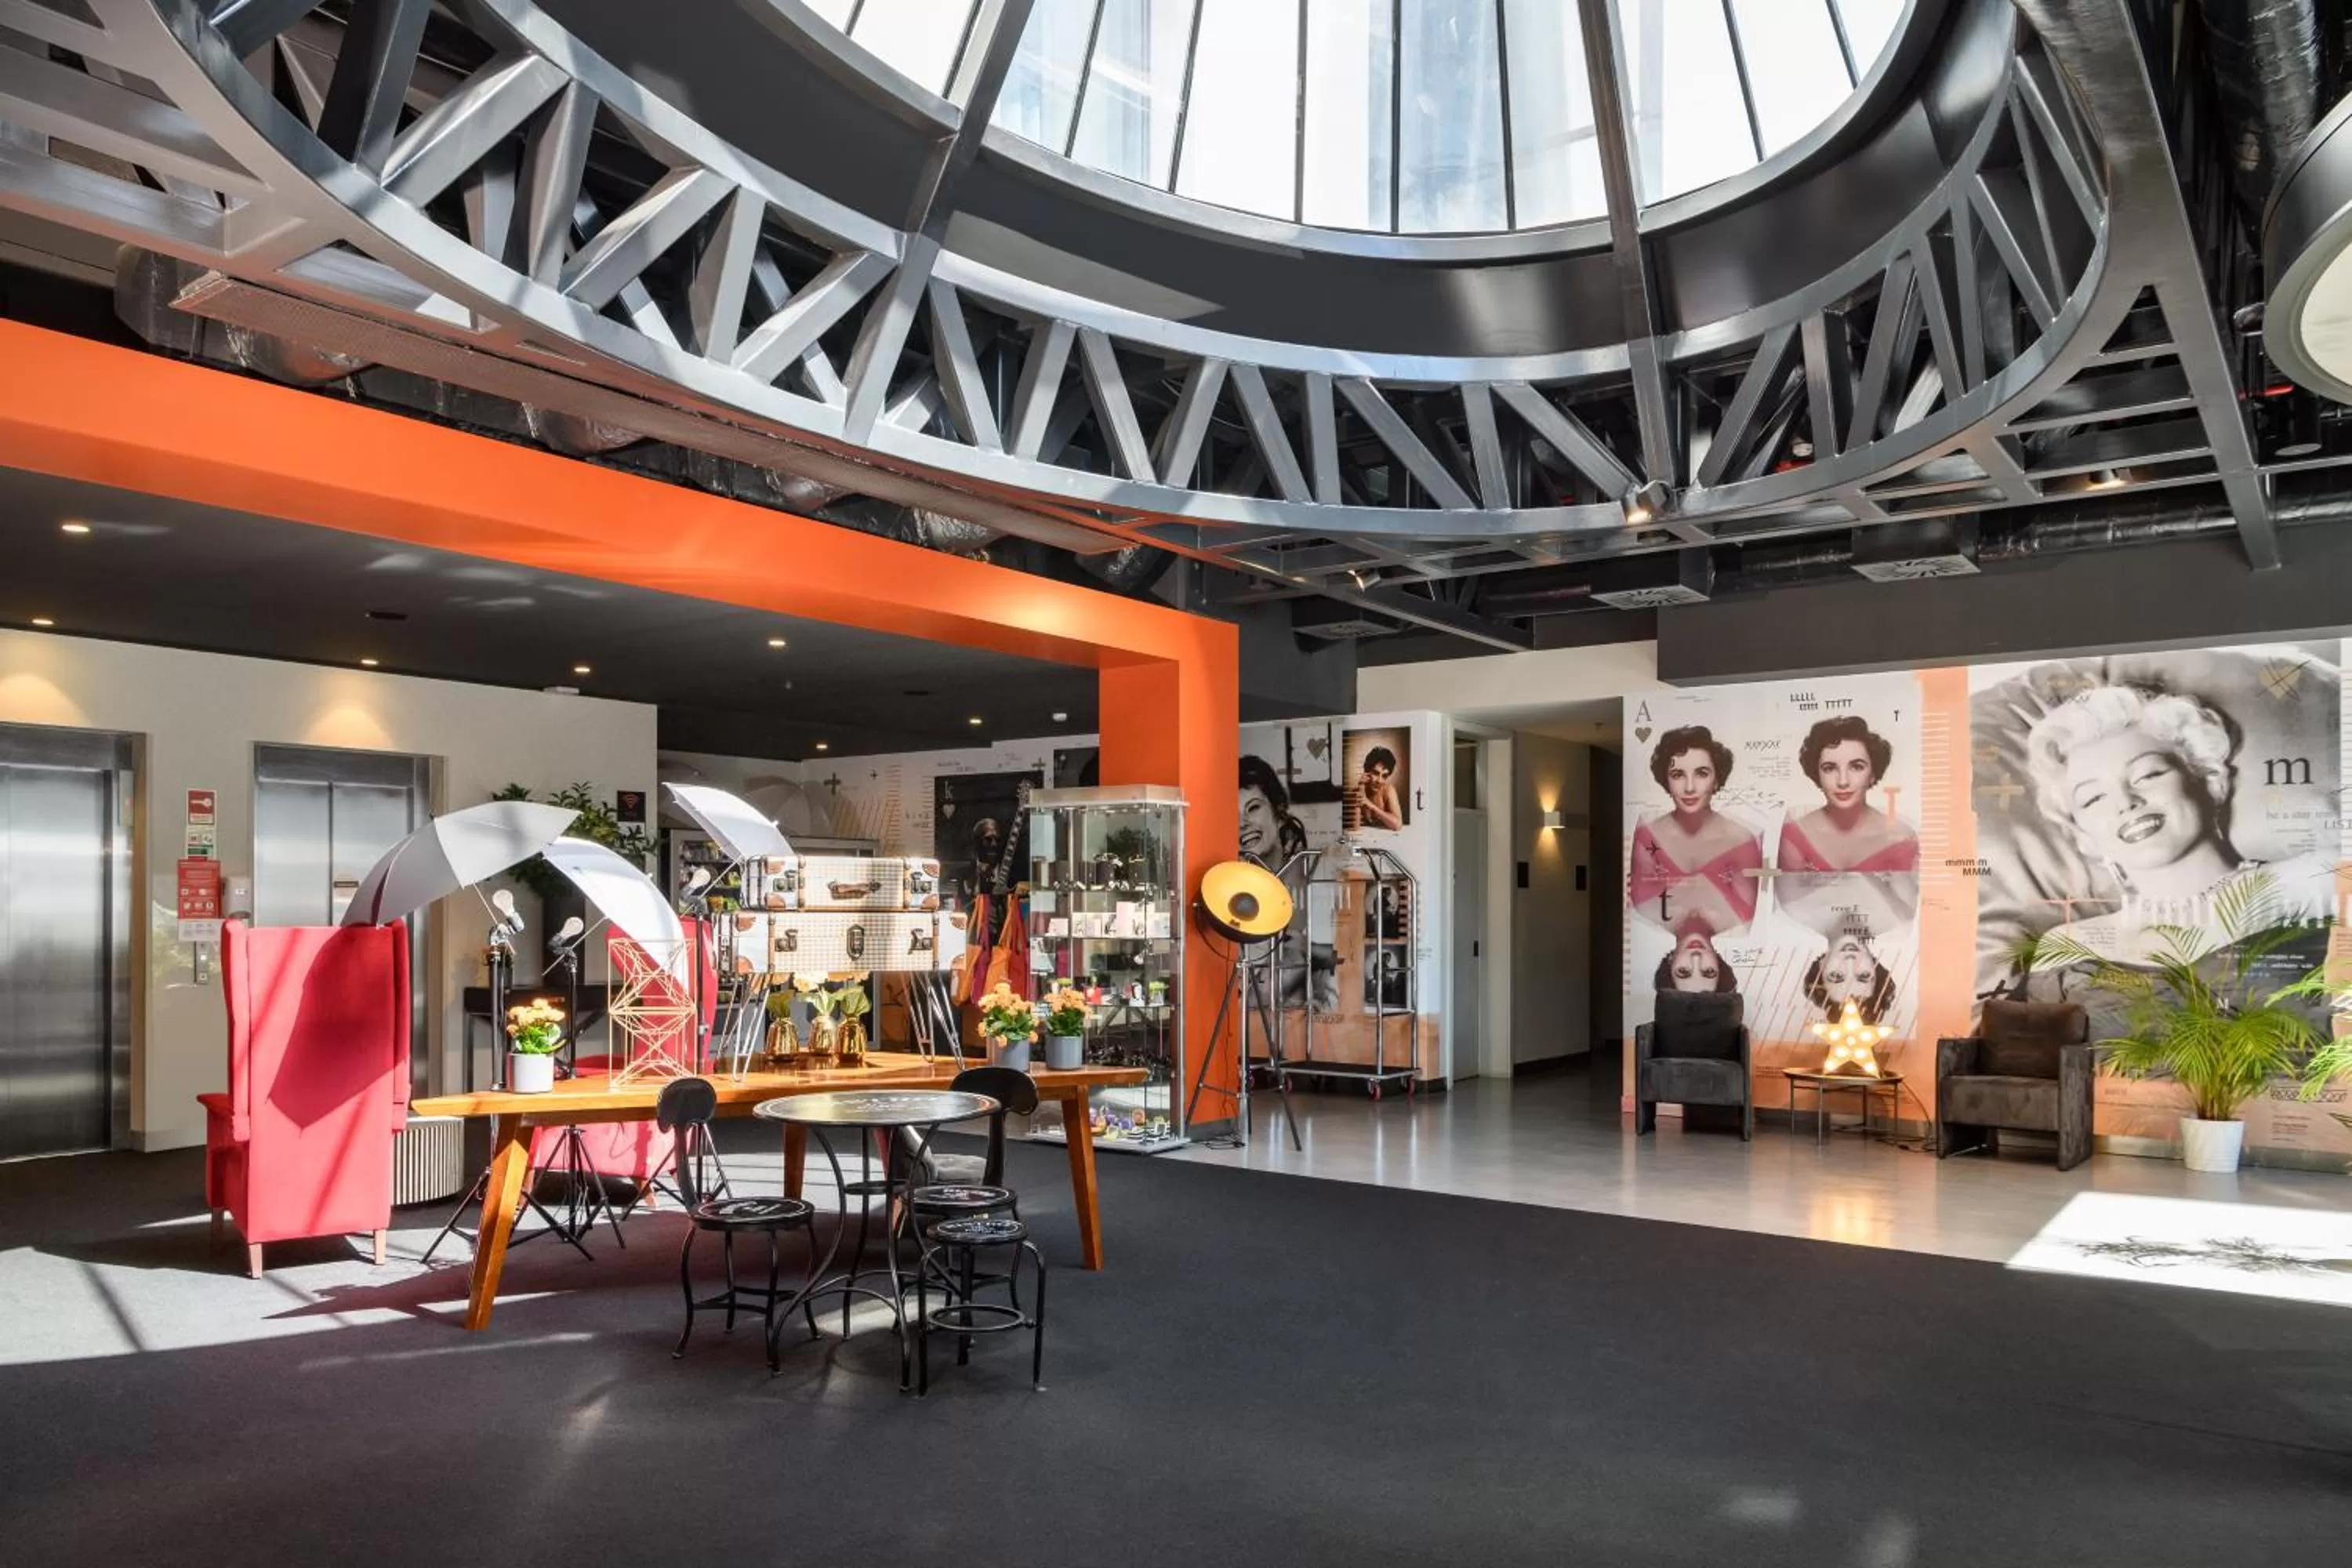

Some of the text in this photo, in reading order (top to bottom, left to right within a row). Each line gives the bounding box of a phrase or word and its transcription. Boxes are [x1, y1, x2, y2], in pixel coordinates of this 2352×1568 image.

[1635, 699, 1652, 723] A
[2263, 757, 2315, 786] m
[1416, 786, 1425, 811] t
[1659, 888, 1675, 921] t
